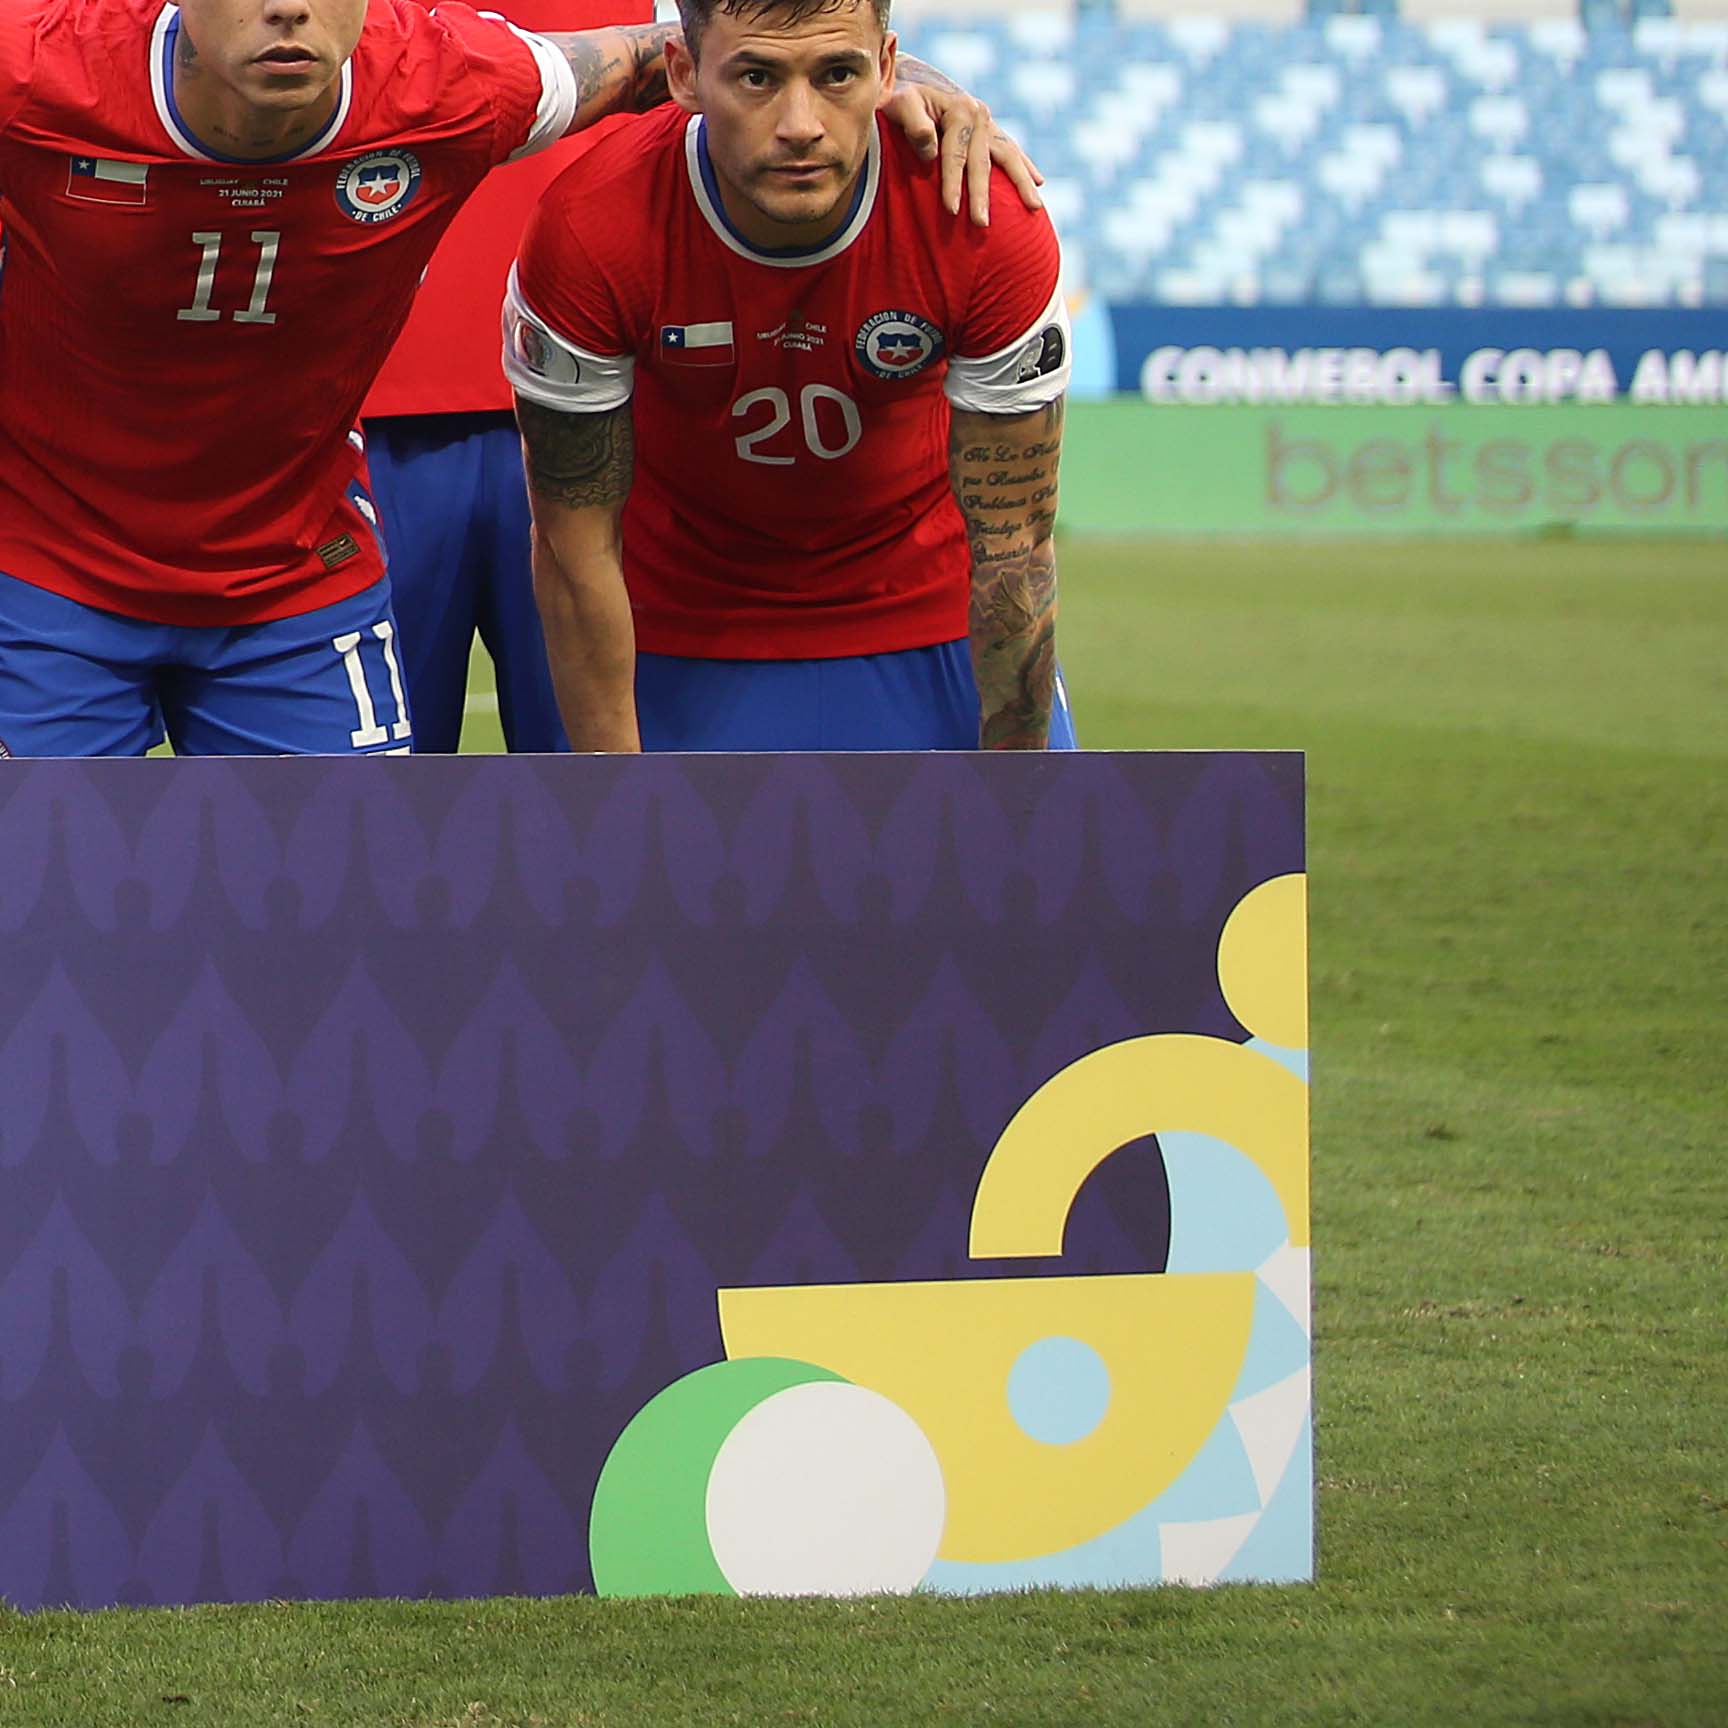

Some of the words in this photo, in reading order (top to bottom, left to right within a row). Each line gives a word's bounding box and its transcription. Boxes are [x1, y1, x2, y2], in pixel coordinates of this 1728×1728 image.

[177, 231, 281, 324] 11
[1144, 345, 1455, 405] CONMEBOL
[1460, 347, 1618, 405] COPA
[1629, 348, 1728, 405] AM
[732, 383, 862, 465] 20
[333, 620, 412, 748] 11
